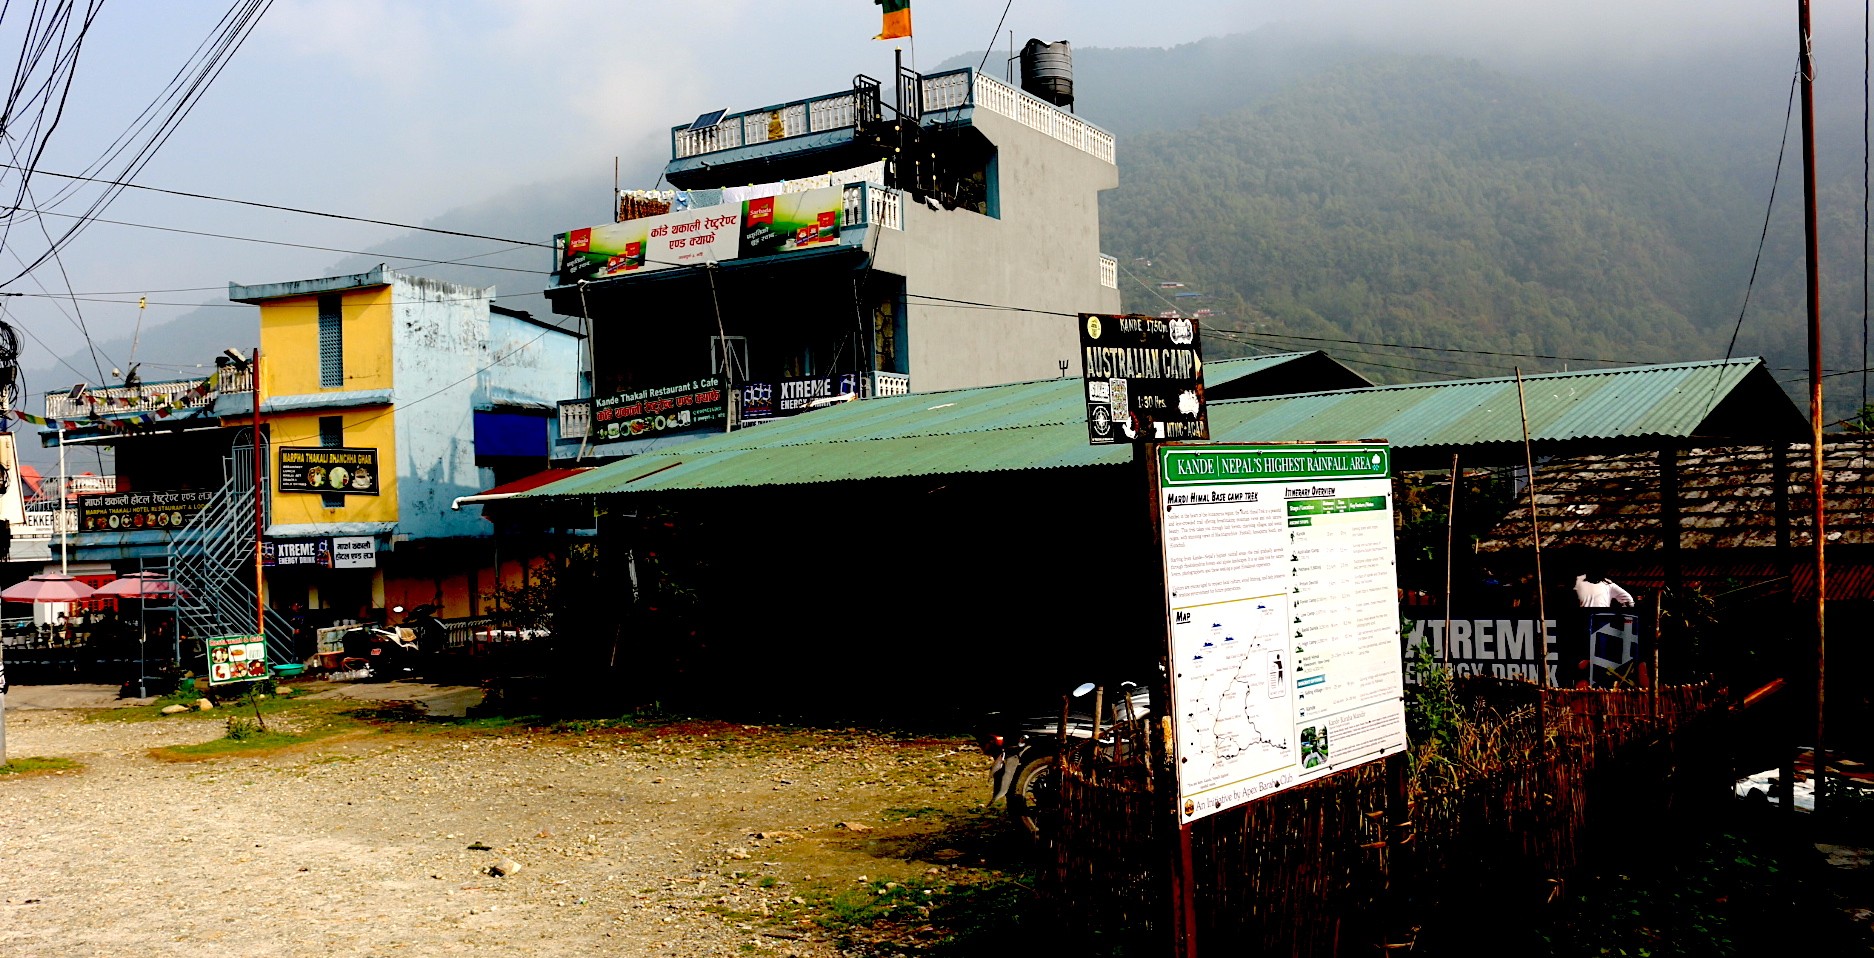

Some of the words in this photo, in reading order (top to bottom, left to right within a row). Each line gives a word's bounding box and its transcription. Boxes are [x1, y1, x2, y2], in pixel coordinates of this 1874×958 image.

[1120, 319, 1143, 333] KANDE
[1087, 347, 1160, 379] AUSTRALIAN
[1163, 349, 1193, 380] CAMP
[596, 396, 619, 407] Kande
[621, 390, 648, 403] Thakali
[650, 382, 690, 398] Restaurant
[693, 380, 699, 389] &
[701, 377, 719, 388] Cafe
[781, 378, 832, 399] XTREME
[1138, 395, 1154, 409] 1:30
[283, 453, 305, 463] MARPHA
[306, 453, 329, 463] THAKALI
[358, 454, 372, 465] GHAR
[1178, 459, 1215, 475] KANDE
[1222, 458, 1262, 474] NEPAL'S
[1264, 457, 1306, 473] HIGHEST
[1308, 456, 1348, 472] RAINFALL
[1350, 456, 1371, 470] AREA
[105, 494, 129, 505] थकाली
[131, 494, 150, 505] होटल
[278, 543, 315, 557] XTREME
[279, 557, 298, 565] ENERGY
[1404, 620, 1558, 660] XTREME
[1196, 800, 1206, 811] An
[1234, 790, 1241, 801] by
[1243, 786, 1258, 799] Apex
